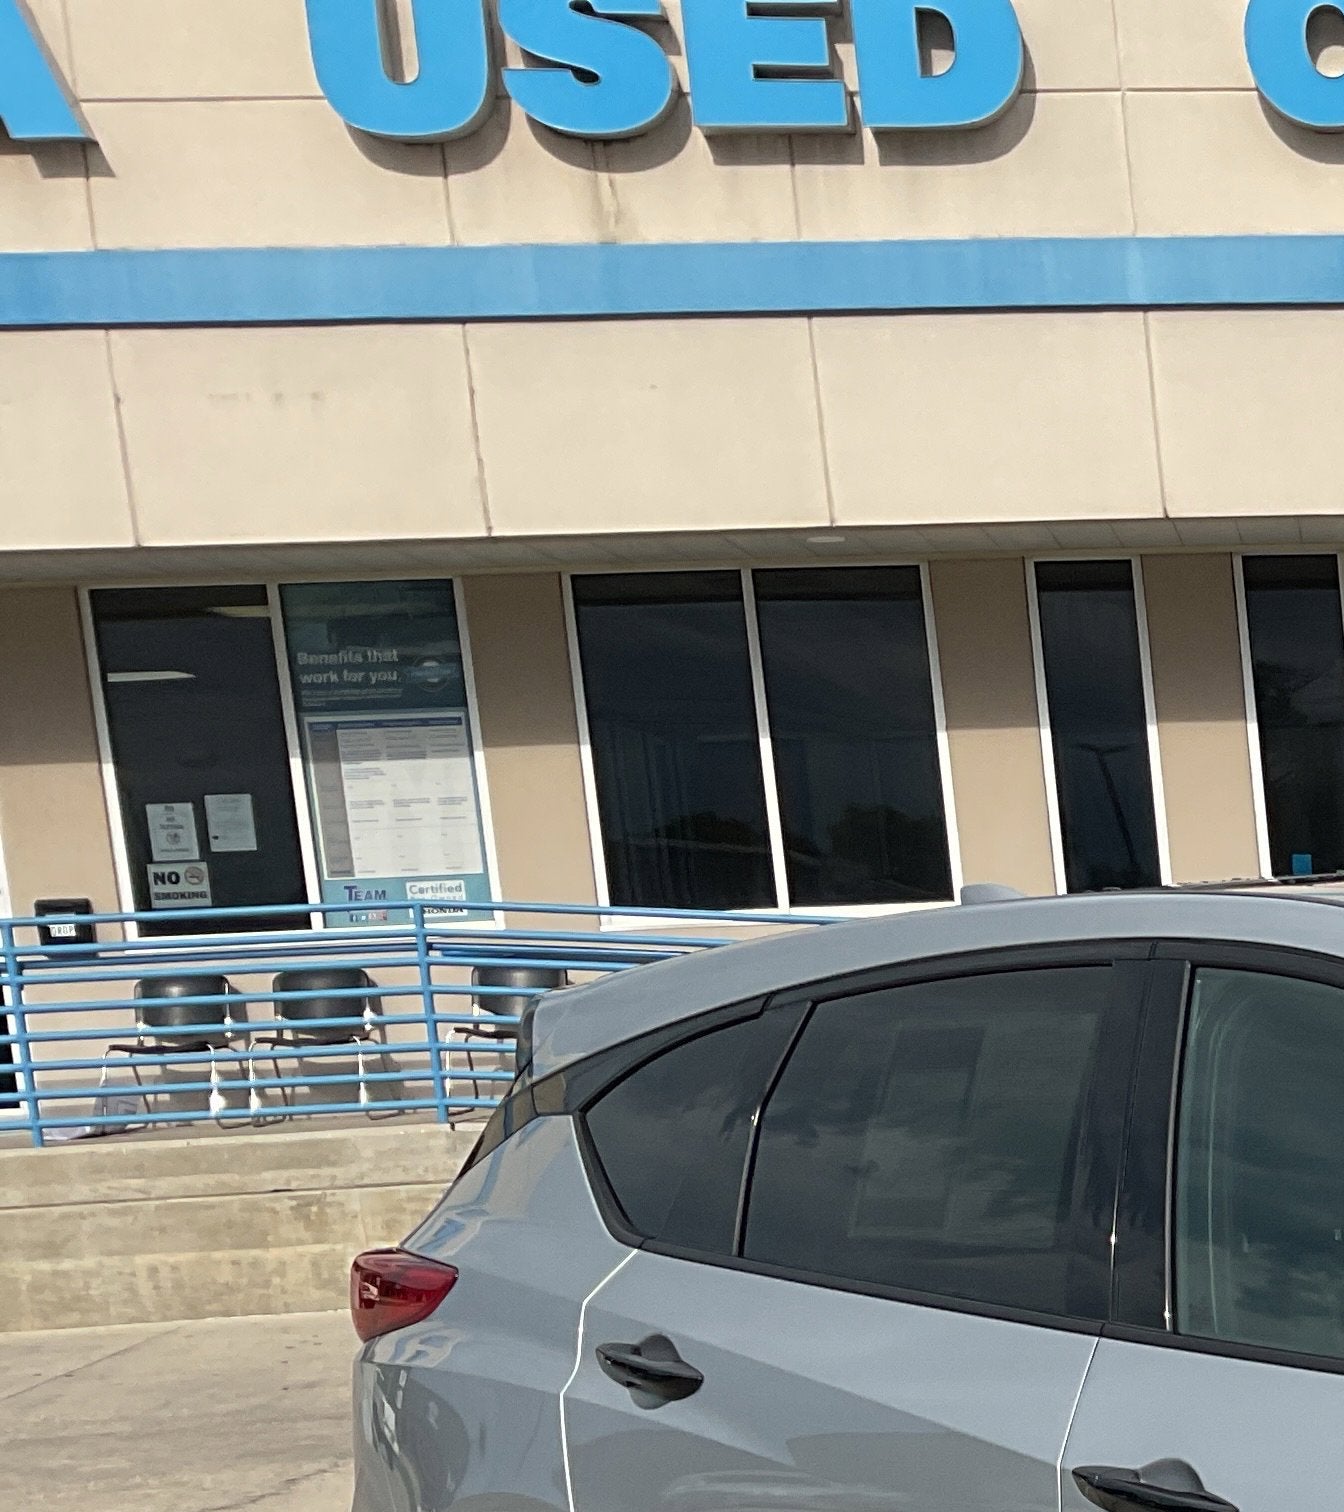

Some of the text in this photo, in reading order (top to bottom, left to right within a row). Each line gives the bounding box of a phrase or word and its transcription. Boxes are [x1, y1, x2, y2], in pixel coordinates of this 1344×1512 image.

[306, 0, 1029, 142] USED
[296, 648, 399, 666] Benefits that
[300, 670, 339, 684] work
[342, 669, 366, 682] for
[152, 871, 180, 886] NO
[154, 890, 208, 900] SMOKING
[344, 885, 386, 901] TEAM
[408, 883, 462, 894] Certified
